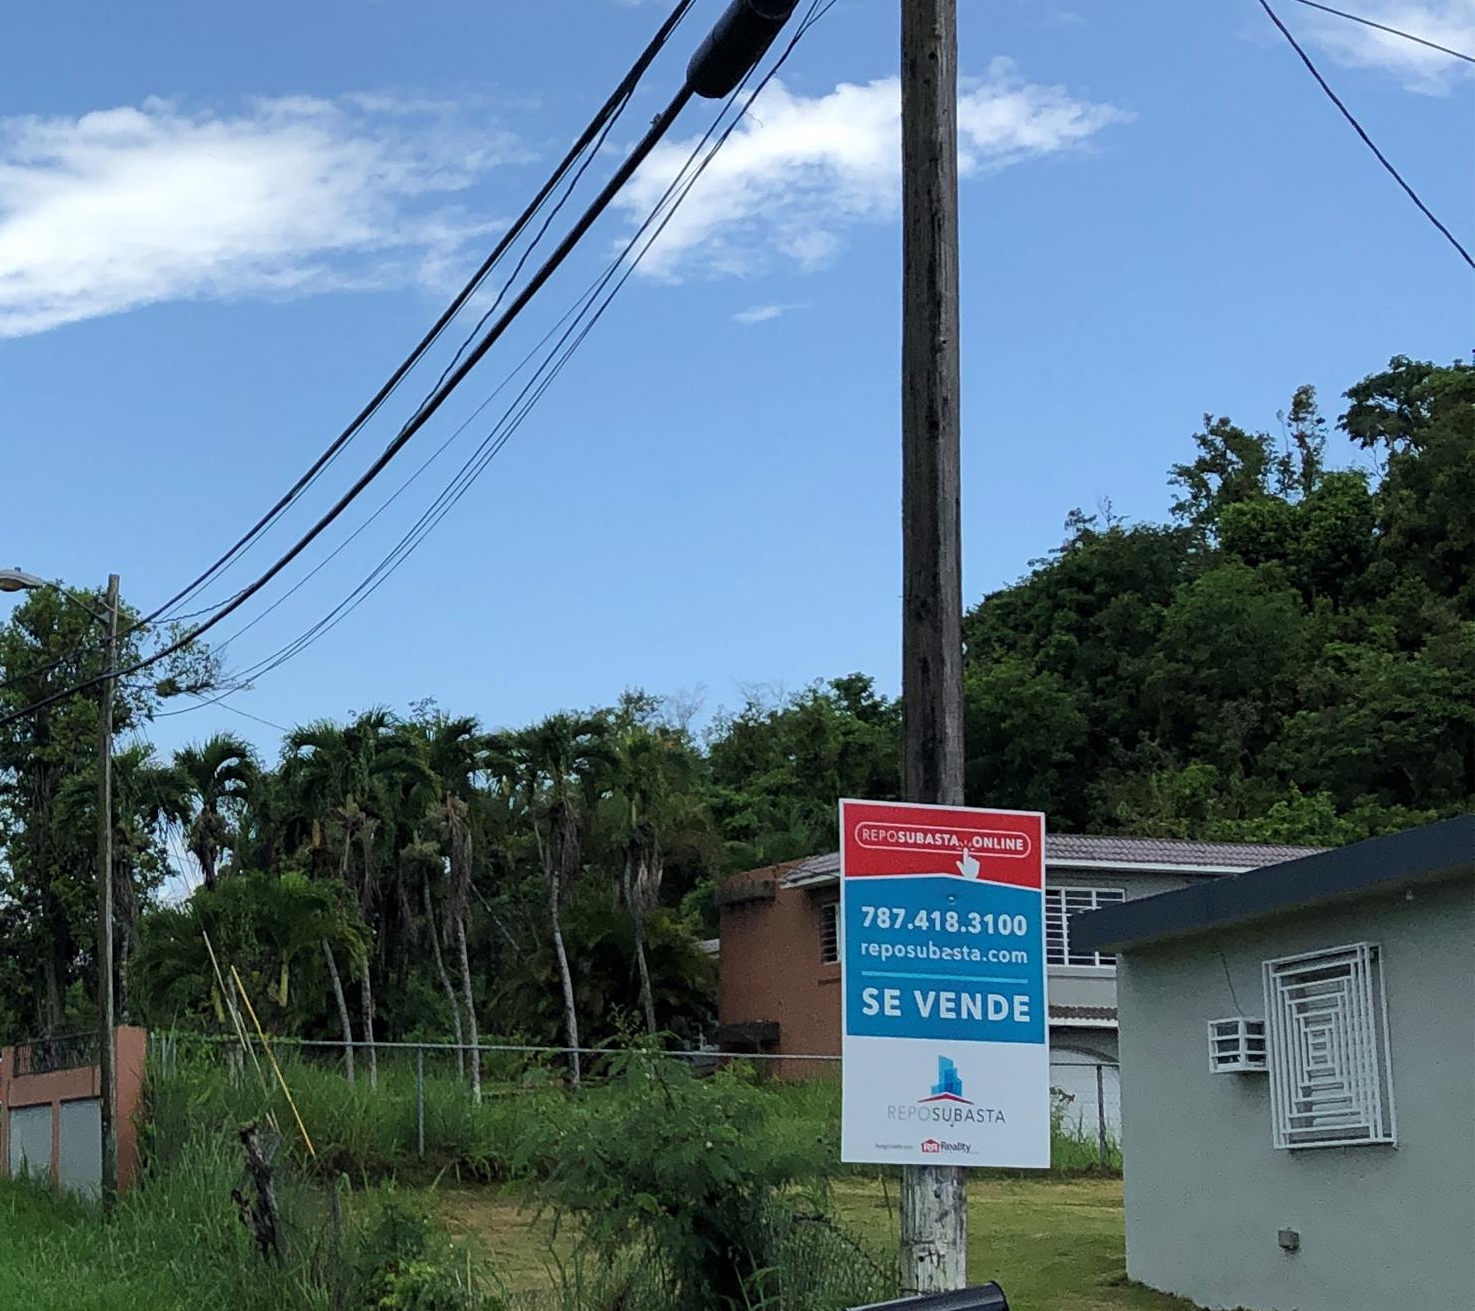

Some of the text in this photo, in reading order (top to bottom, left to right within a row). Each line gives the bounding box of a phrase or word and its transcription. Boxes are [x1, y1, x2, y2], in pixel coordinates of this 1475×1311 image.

[861, 828, 1024, 851] REPOSUBASTA ONLINE
[861, 905, 1028, 937] 787.418.3100
[860, 940, 1028, 964] reposubasta.com
[861, 987, 1031, 1023] SE VENDE
[887, 1105, 1006, 1123] REPOSUBASTA
